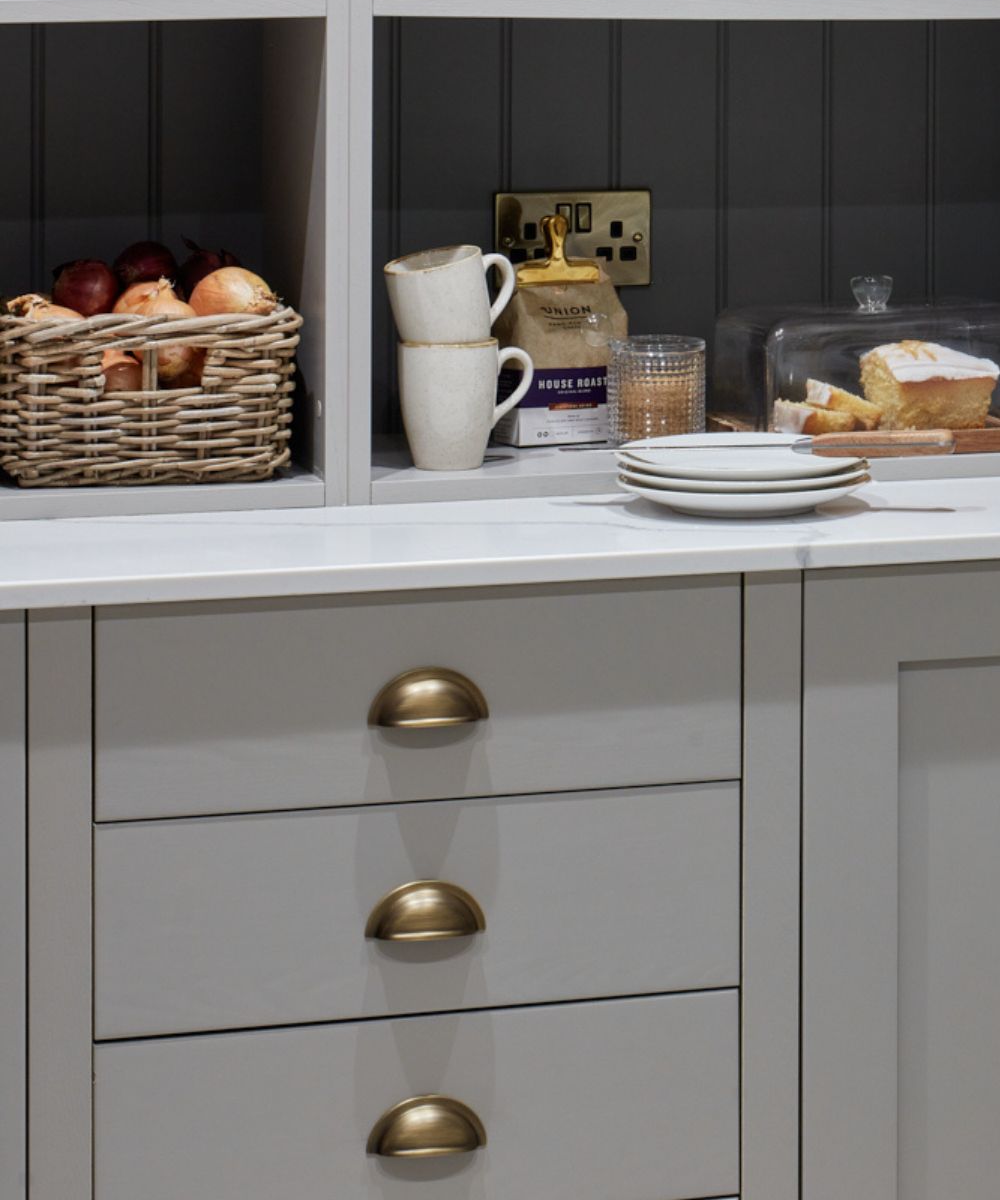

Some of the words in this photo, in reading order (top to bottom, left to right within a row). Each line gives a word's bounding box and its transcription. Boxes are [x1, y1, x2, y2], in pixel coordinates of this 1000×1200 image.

[540, 306, 592, 315] UNION
[538, 378, 573, 390] HOUSE
[577, 376, 608, 388] ROAST
